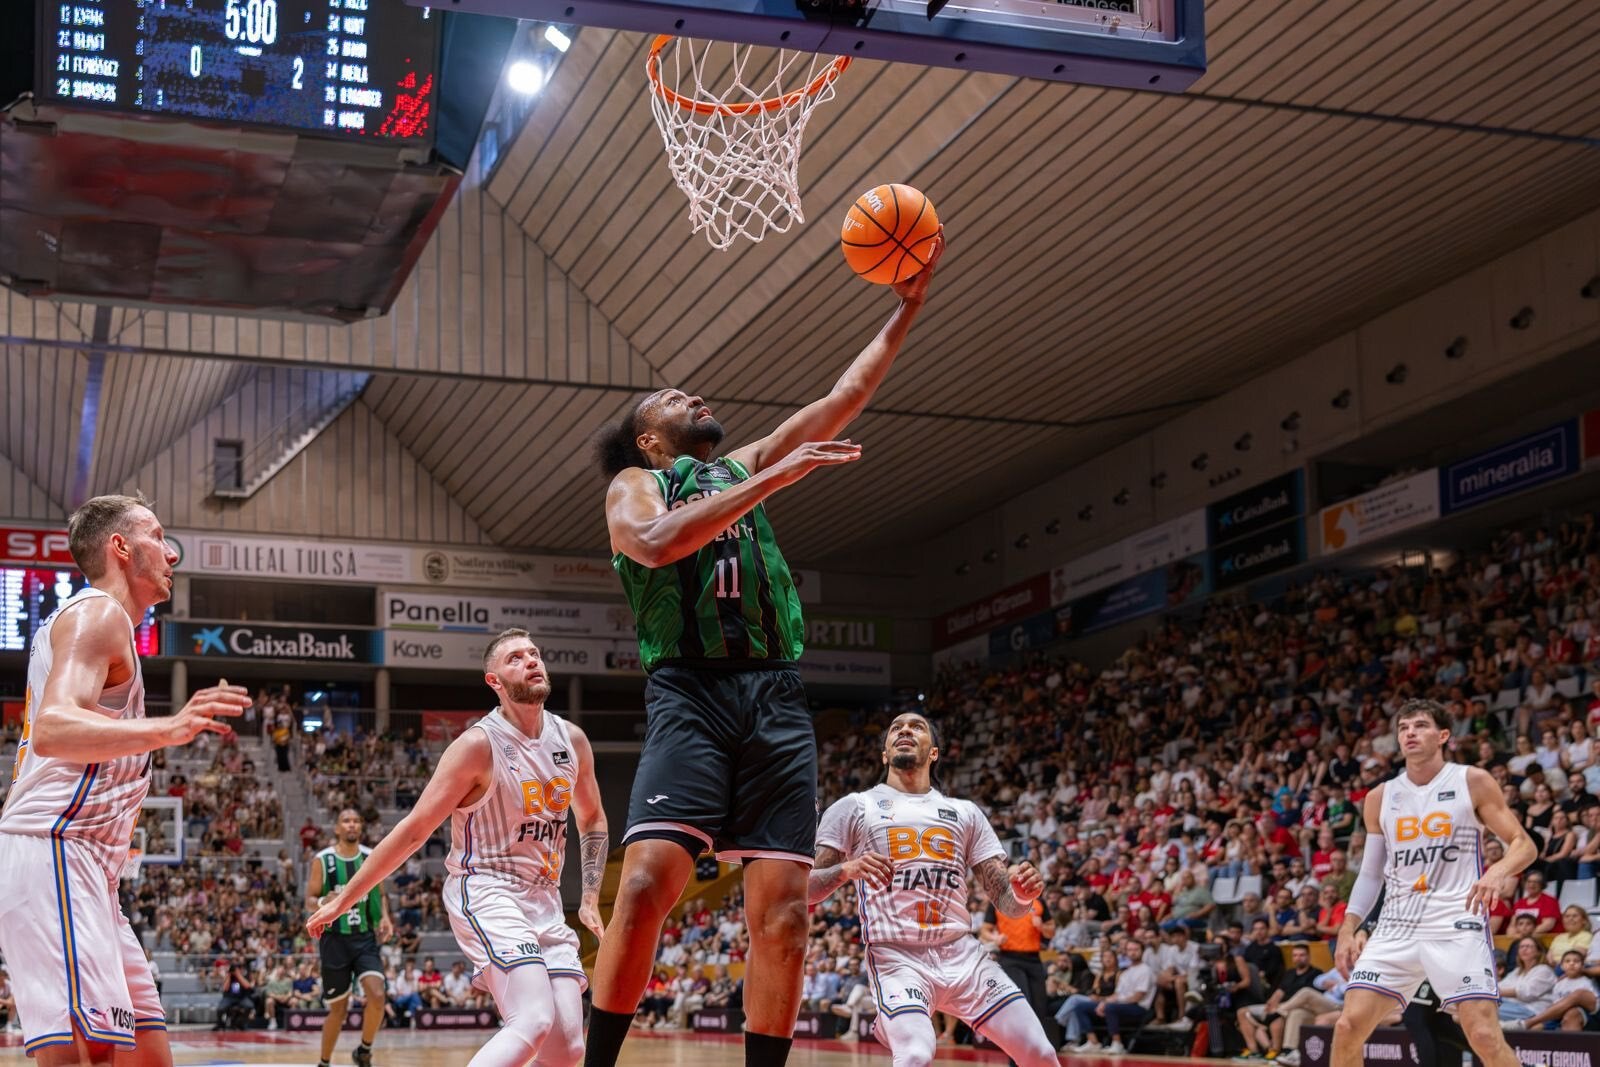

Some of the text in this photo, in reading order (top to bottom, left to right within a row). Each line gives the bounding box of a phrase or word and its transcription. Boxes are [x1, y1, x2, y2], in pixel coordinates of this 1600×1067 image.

[225, 0, 277, 44] 5:00
[190, 45, 201, 77] 0
[291, 55, 304, 90] 2
[1459, 446, 1554, 496] mineralia
[233, 545, 287, 573] LLEAL
[296, 547, 357, 576] TULSÀ
[716, 556, 741, 598] 11
[390, 598, 489, 624] Panella
[230, 629, 355, 658] CaixaBank
[393, 639, 443, 659] Kave
[520, 776, 571, 816] BG
[1396, 811, 1452, 842] BG
[886, 826, 955, 861] BG
[1394, 845, 1460, 868] FIATC
[1411, 873, 1428, 896] 4
[347, 908, 361, 925] 25
[517, 942, 542, 955] YOS
